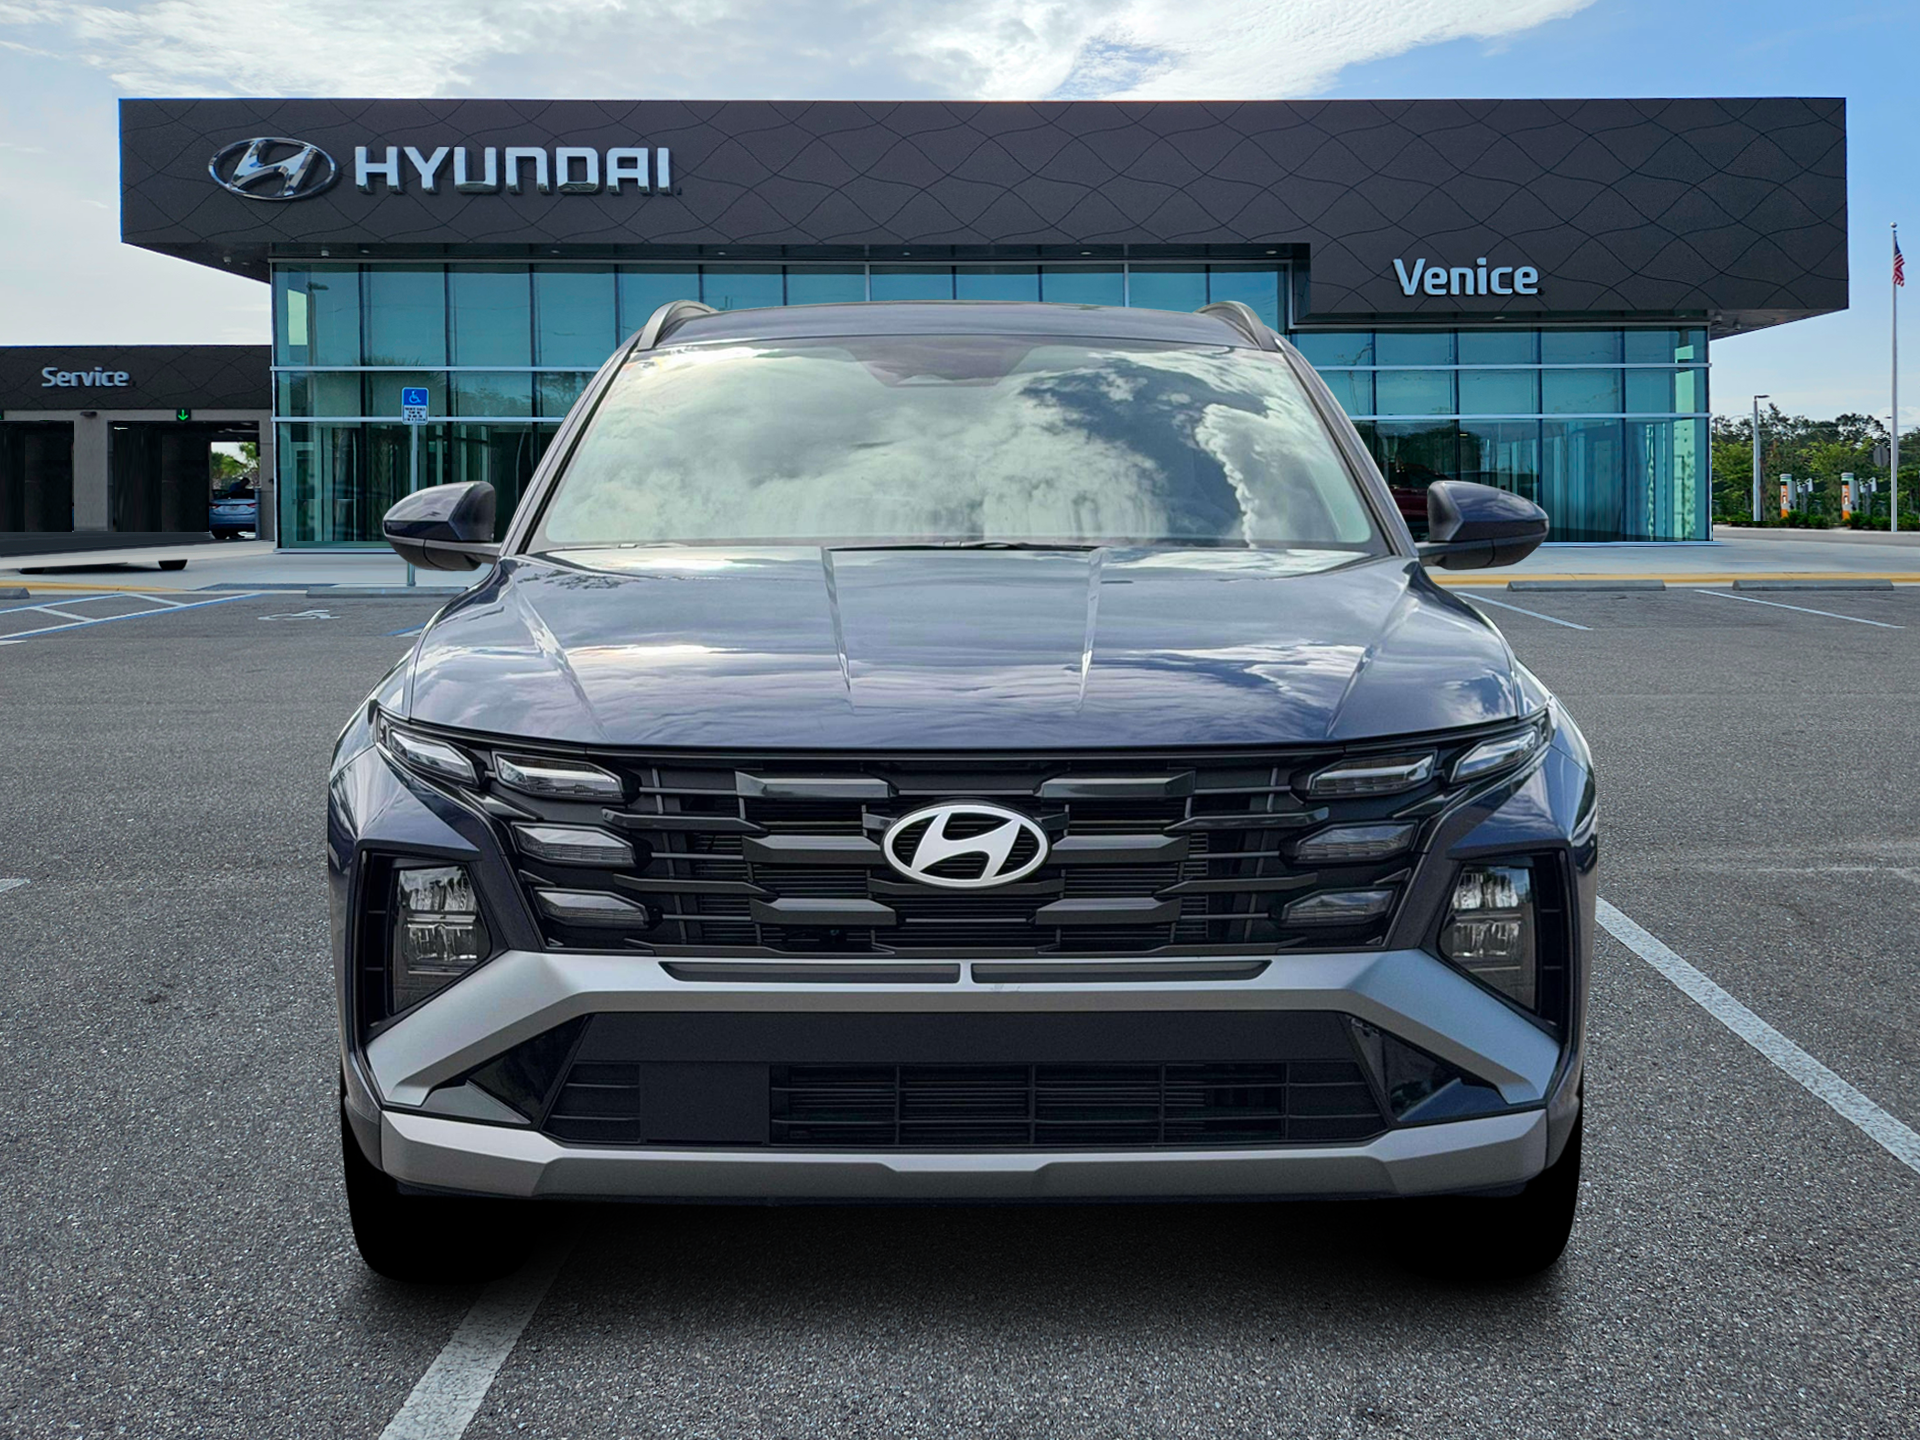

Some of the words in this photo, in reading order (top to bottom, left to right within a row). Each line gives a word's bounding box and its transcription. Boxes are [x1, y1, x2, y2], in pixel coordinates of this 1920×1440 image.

[354, 146, 671, 194] HYUNDAI
[1393, 257, 1539, 296] Venice
[41, 366, 130, 387] Service
